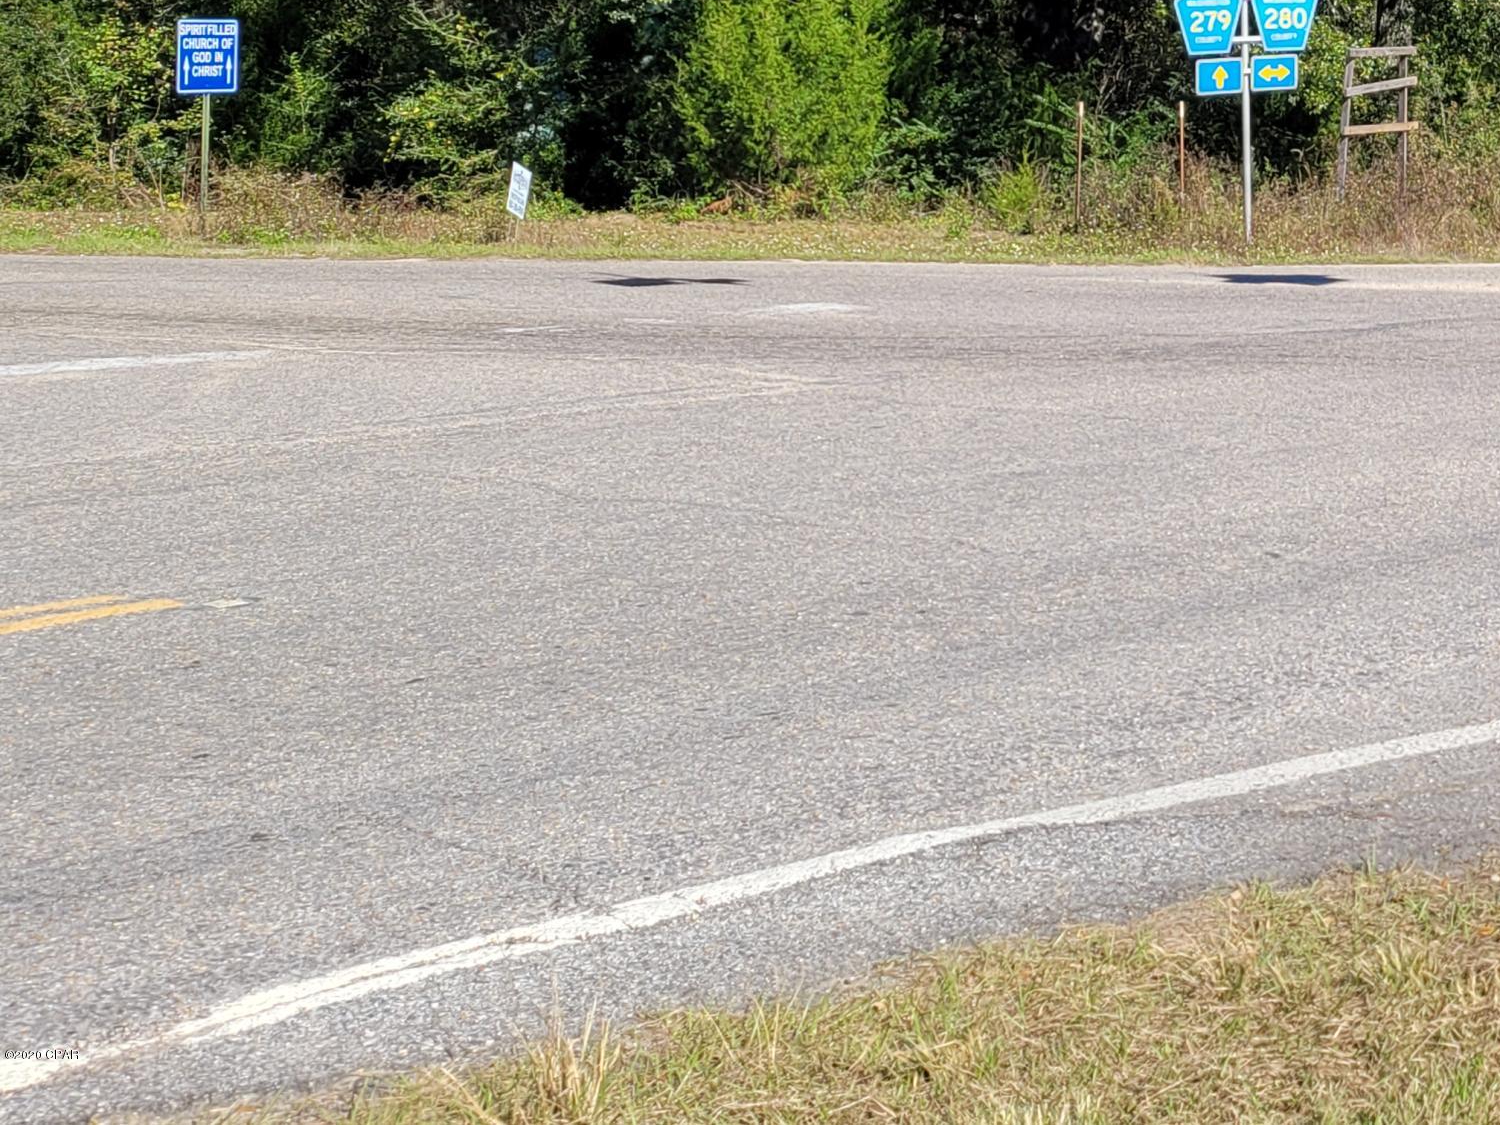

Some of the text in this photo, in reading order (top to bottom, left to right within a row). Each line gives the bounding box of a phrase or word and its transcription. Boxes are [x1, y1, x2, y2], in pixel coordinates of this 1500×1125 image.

[1190, 9, 1232, 33] 279
[1263, 7, 1308, 30] 280
[182, 38, 234, 49] CHURCH OF
[192, 51, 224, 63] GOD IN
[192, 65, 224, 77] CHRIST
